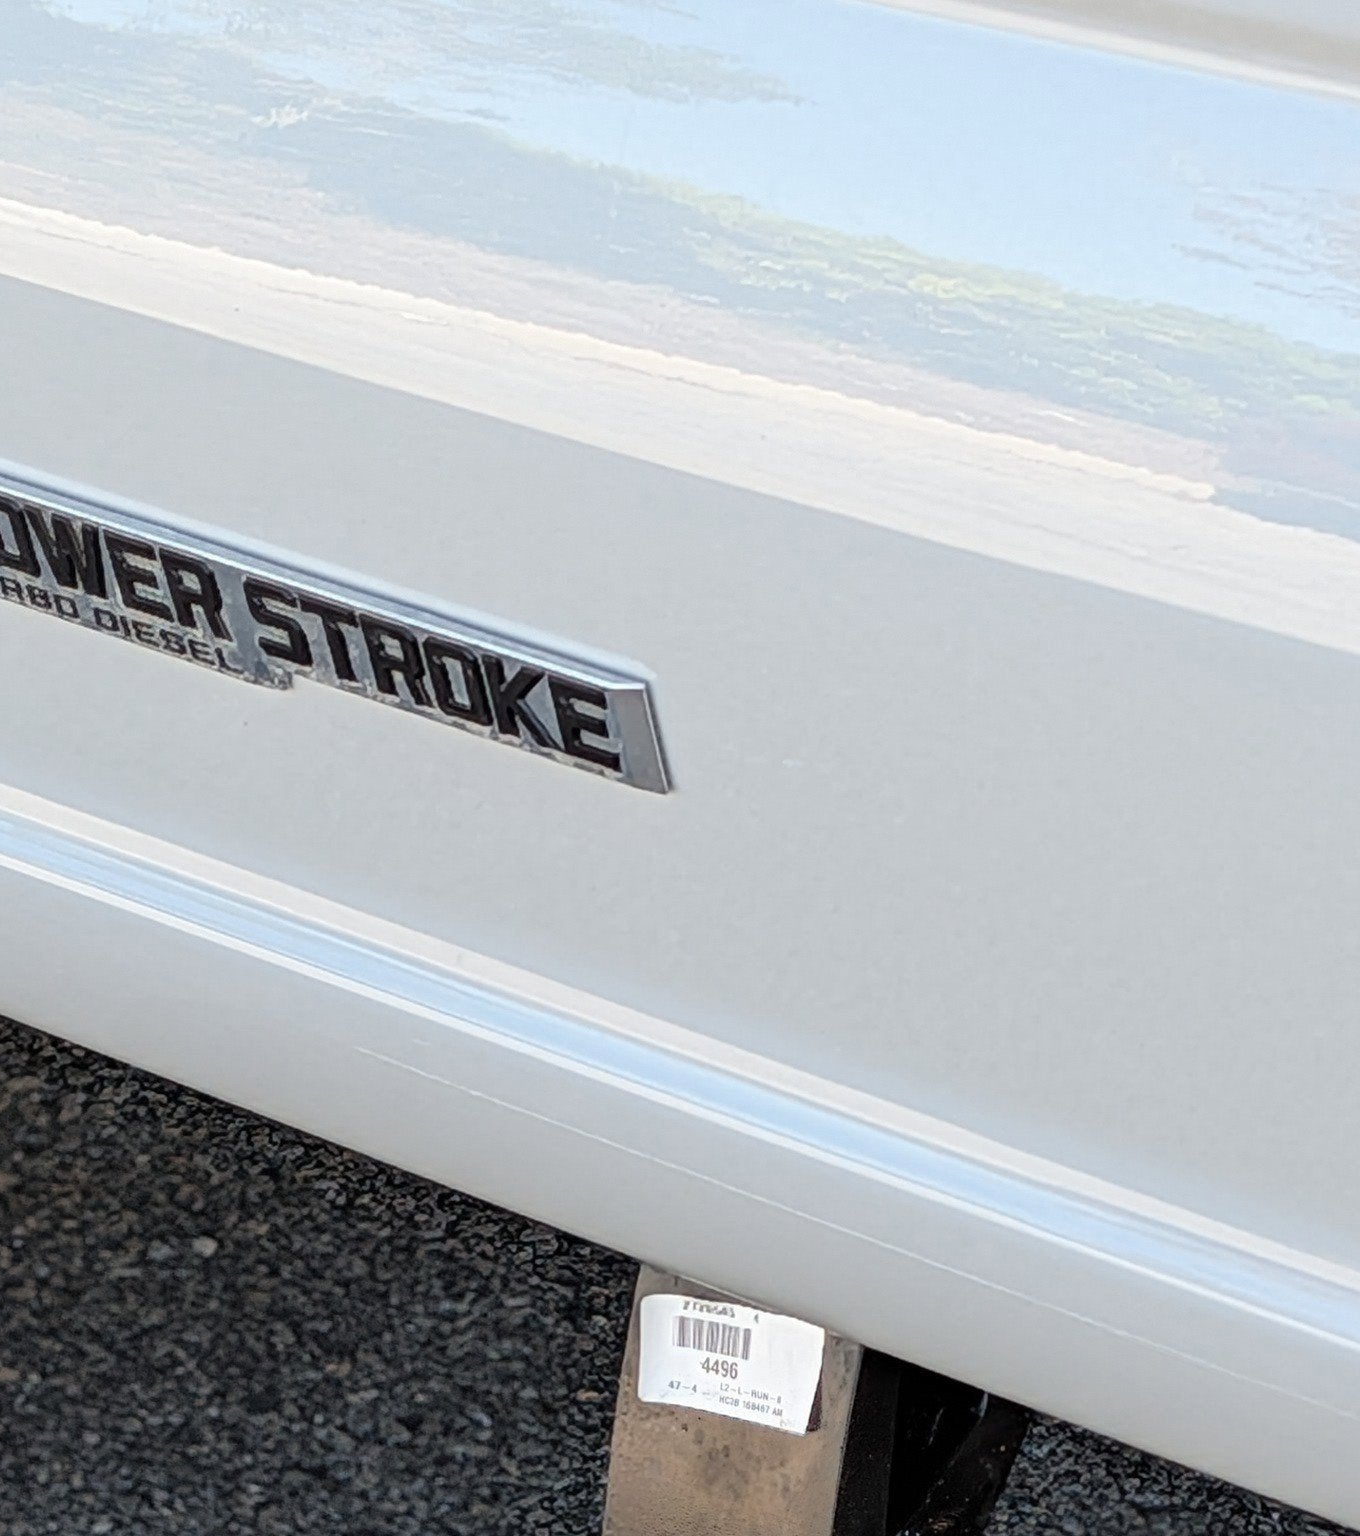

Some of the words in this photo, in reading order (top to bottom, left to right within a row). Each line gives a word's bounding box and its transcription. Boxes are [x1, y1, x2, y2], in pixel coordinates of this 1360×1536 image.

[93, 607, 246, 674] DIESEL
[242, 575, 624, 774] STROKE
[700, 1356, 739, 1380] 4496
